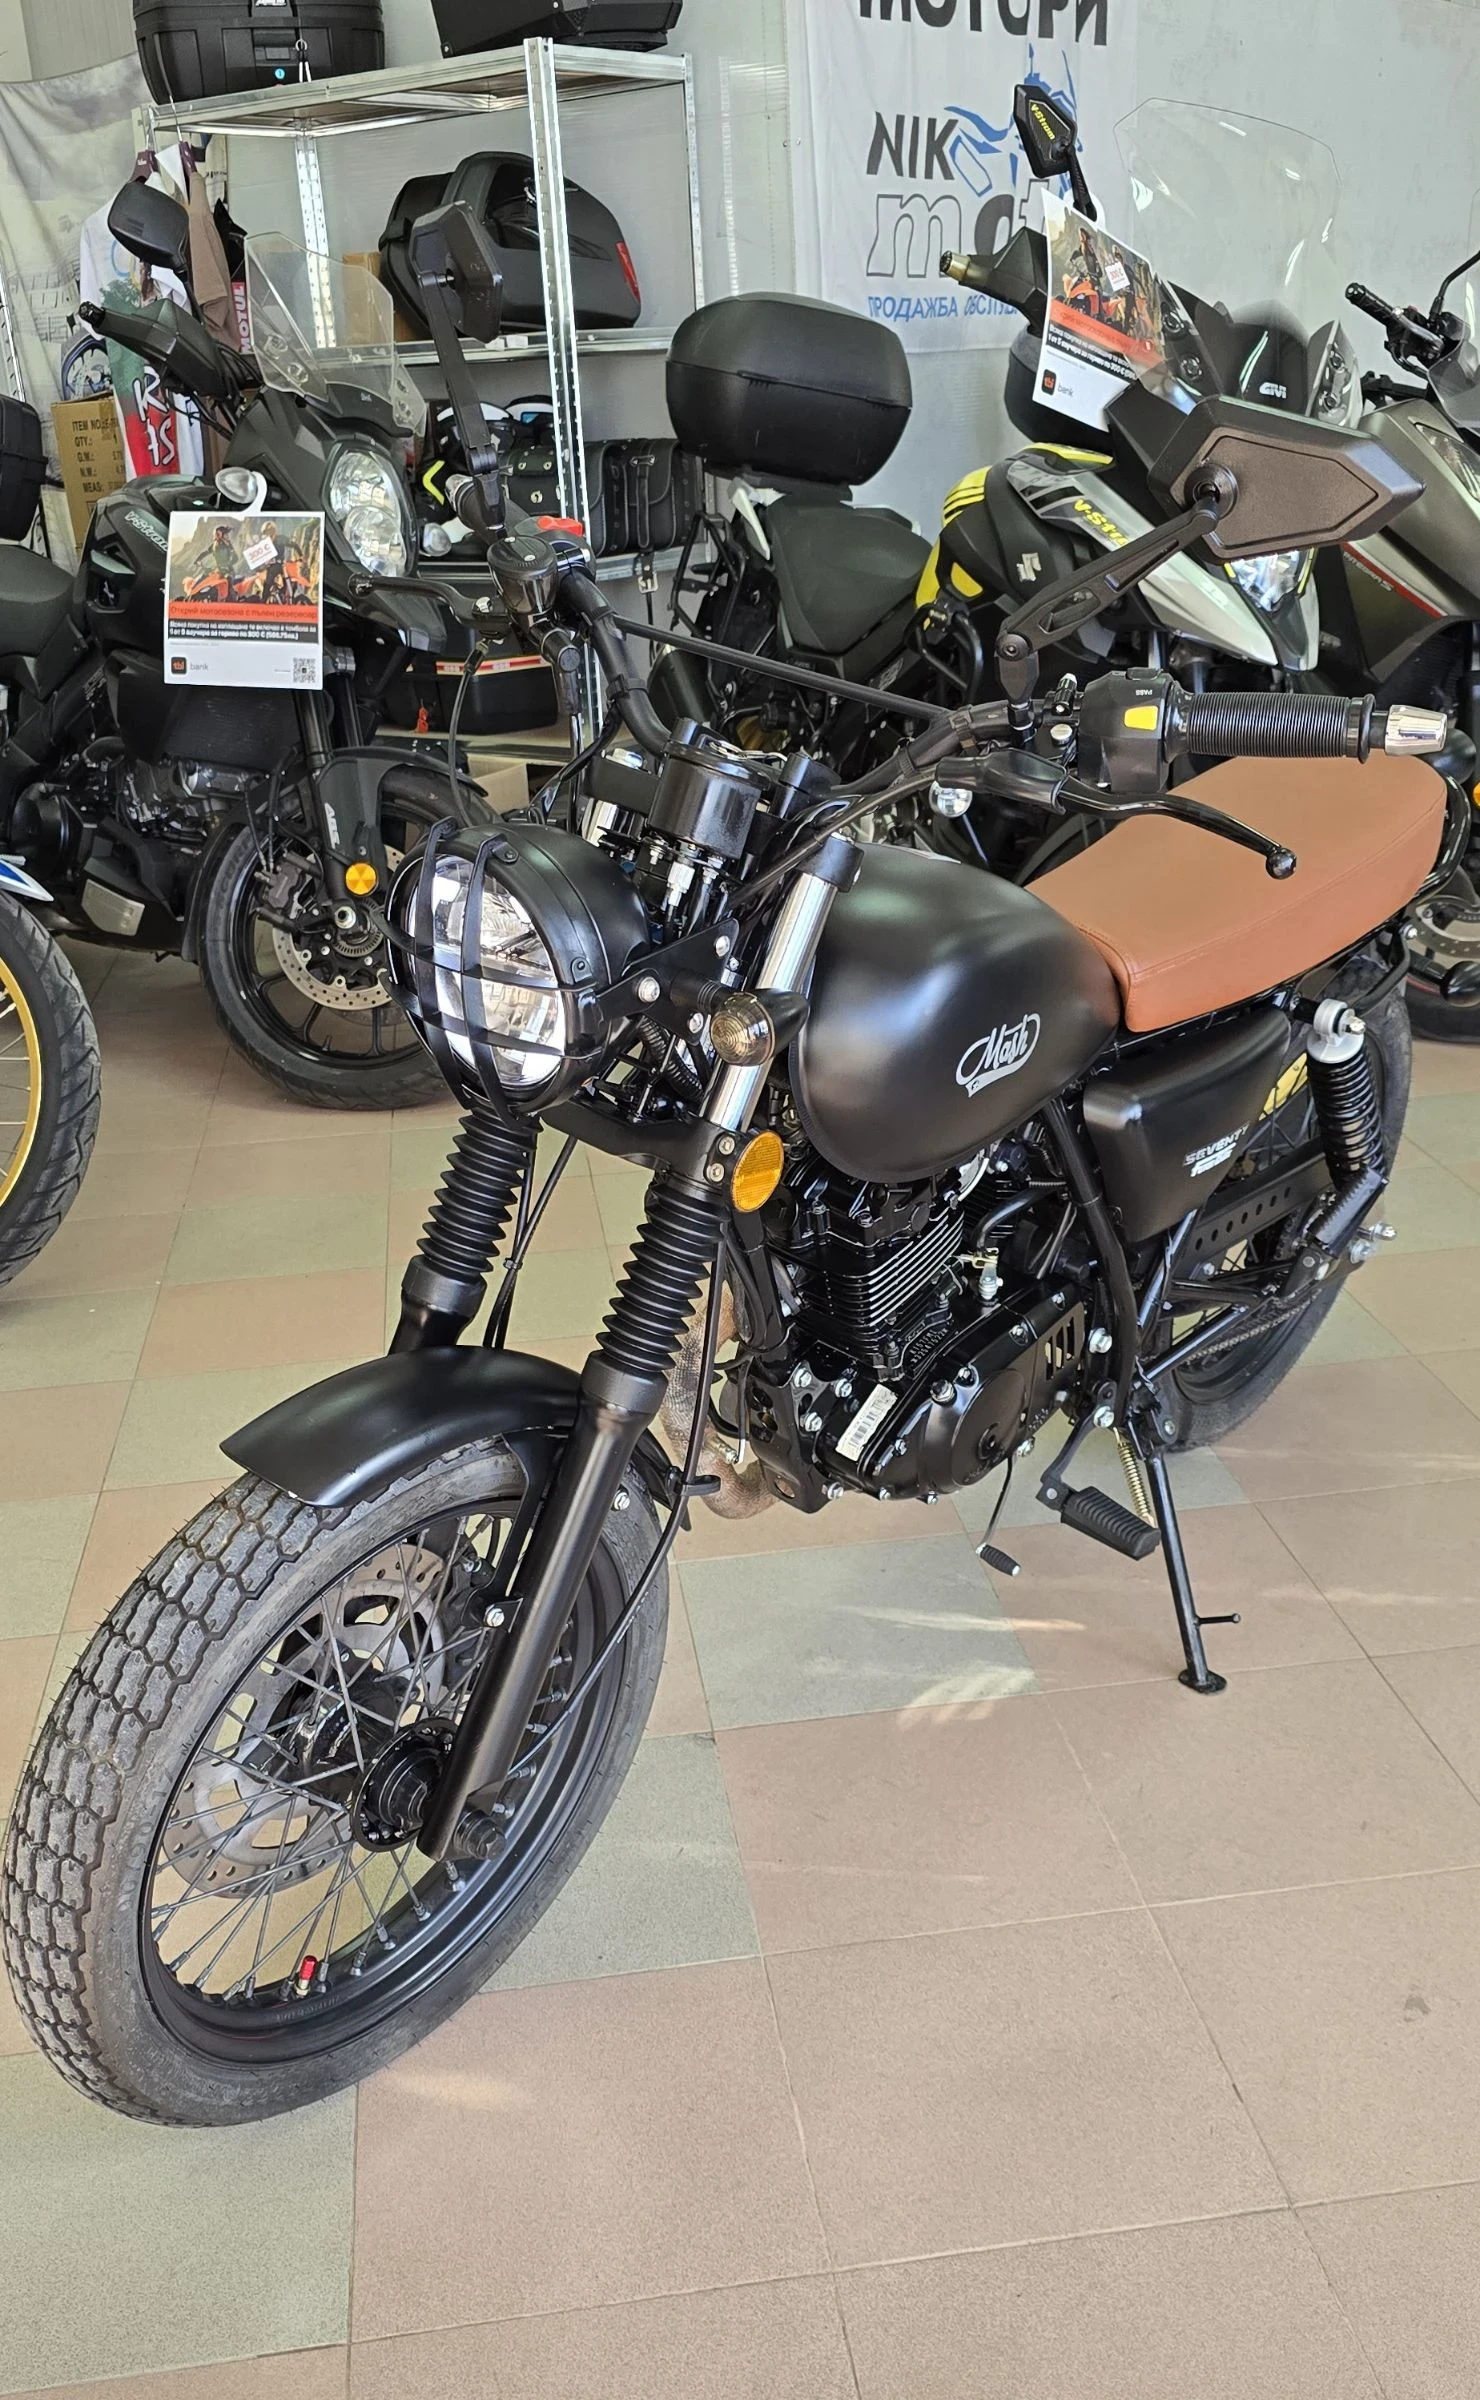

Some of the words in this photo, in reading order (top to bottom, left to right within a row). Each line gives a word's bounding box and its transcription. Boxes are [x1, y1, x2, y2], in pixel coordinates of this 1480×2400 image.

[860, 0, 1107, 46] ТОРИ
[866, 111, 958, 180] NIK
[1031, 103, 1056, 140] V-Strom
[866, 178, 1050, 278] mot
[233, 286, 253, 353] MOTUL
[868, 296, 958, 322] ПРОДАЖБА
[1073, 499, 1129, 549] V-Stro
[956, 1012, 1041, 1086] Mash
[1183, 1120, 1251, 1167] SEVENTY
